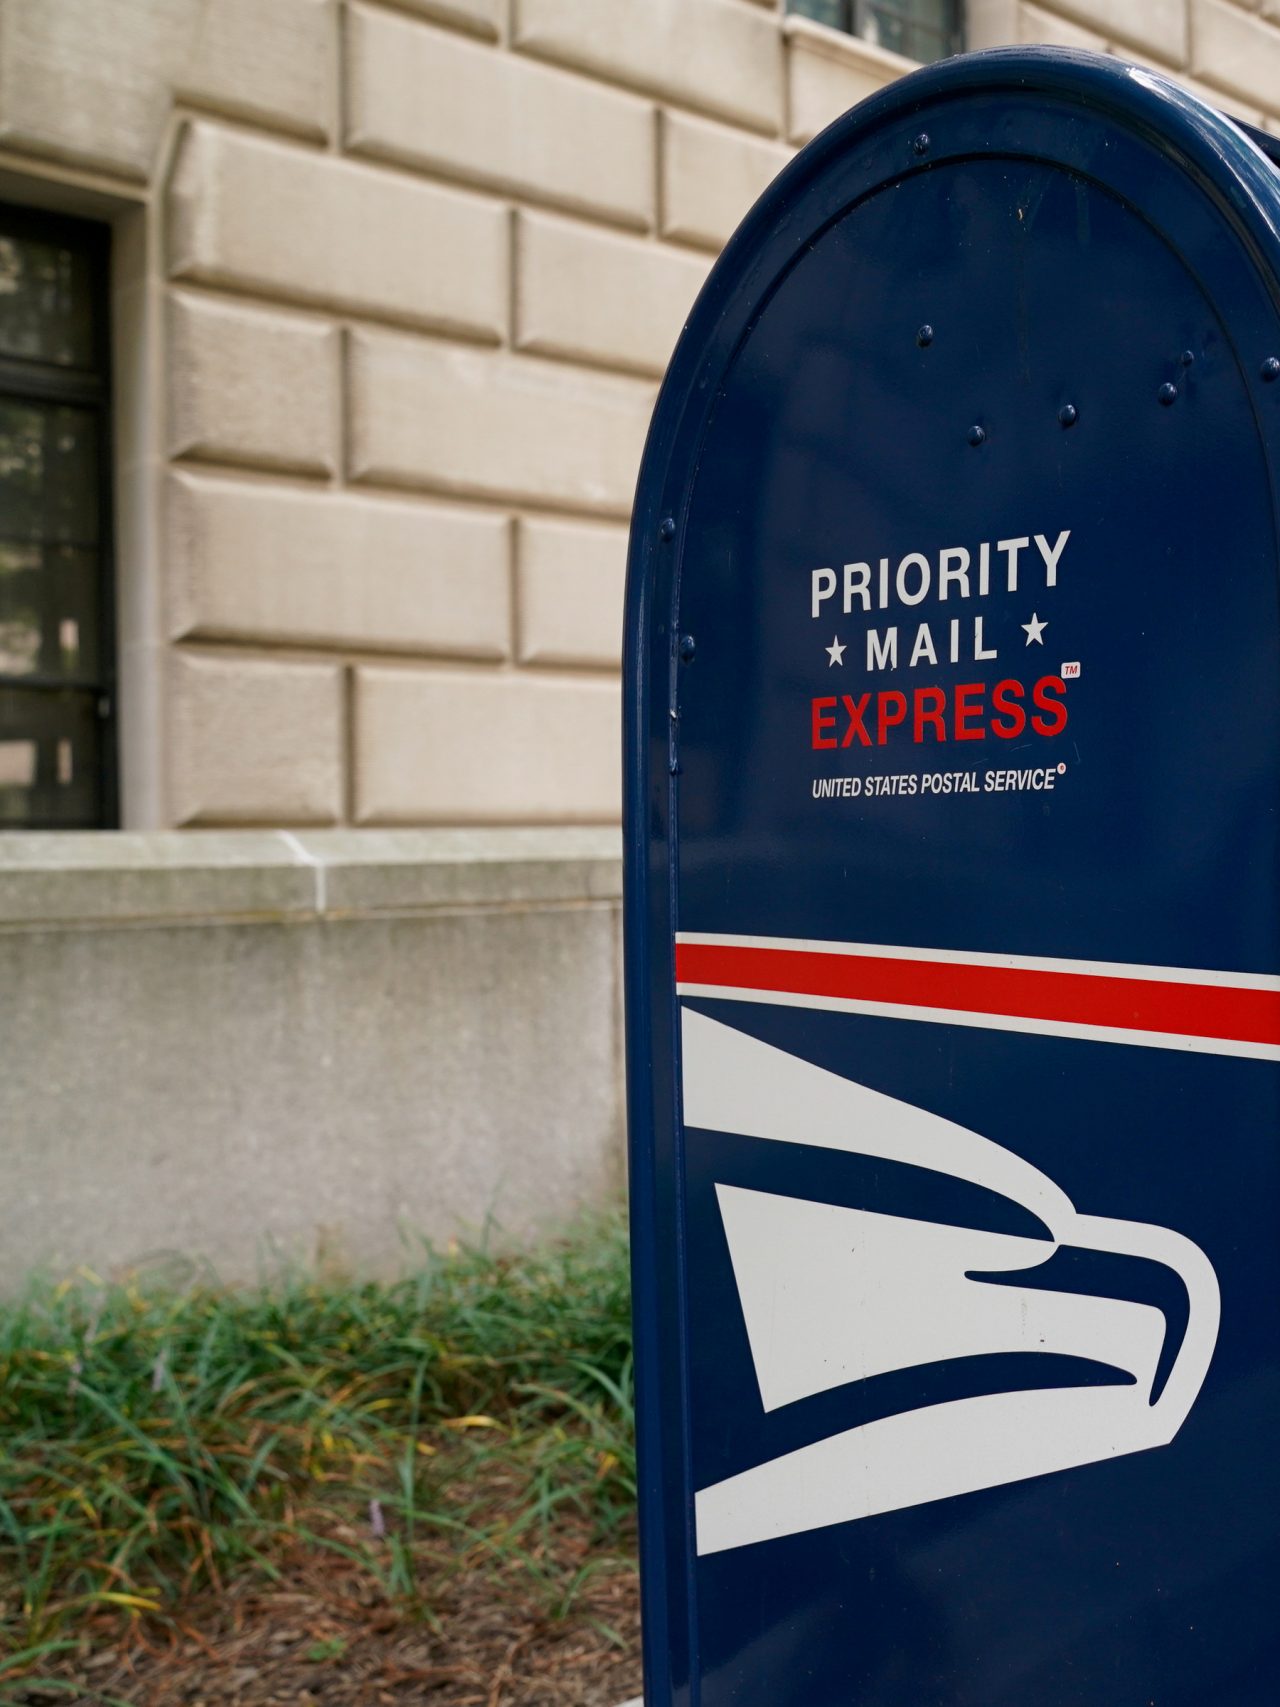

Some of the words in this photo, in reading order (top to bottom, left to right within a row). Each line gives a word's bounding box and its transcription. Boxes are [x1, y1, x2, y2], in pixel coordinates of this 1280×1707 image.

[812, 530, 1071, 618] PRIORITY
[866, 616, 997, 671] MAIL
[812, 675, 1068, 750] EXPRESS
[812, 778, 861, 798] UNITED
[864, 775, 917, 797] STATES
[921, 772, 980, 794] POSTAL
